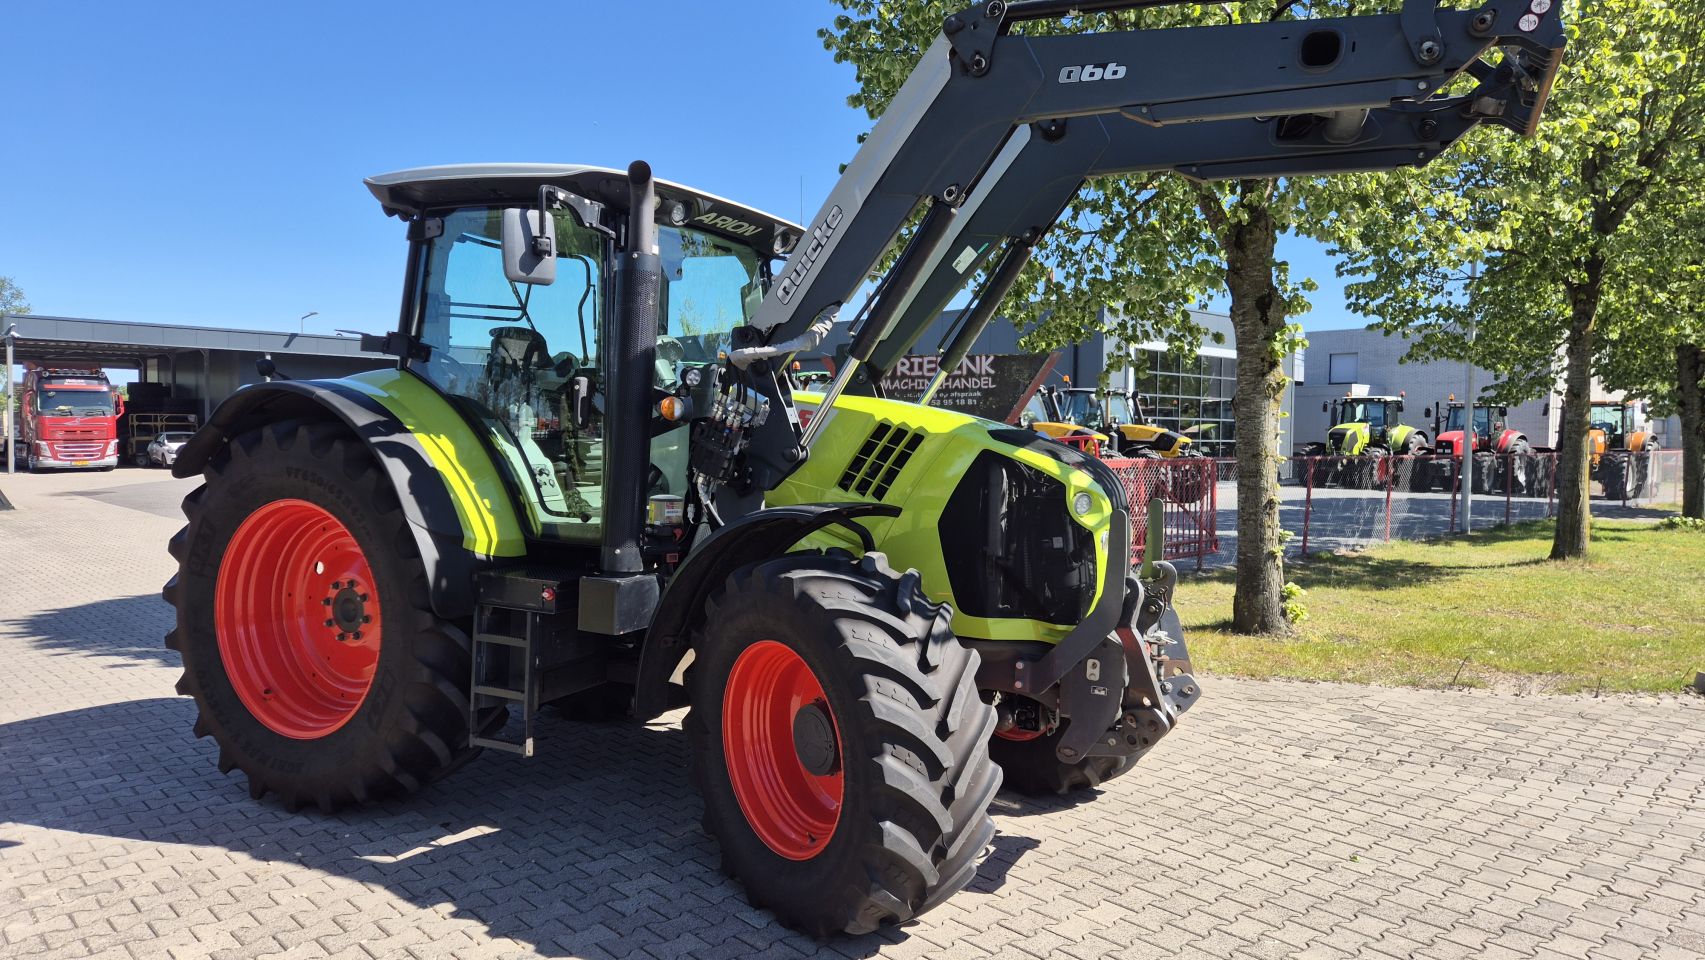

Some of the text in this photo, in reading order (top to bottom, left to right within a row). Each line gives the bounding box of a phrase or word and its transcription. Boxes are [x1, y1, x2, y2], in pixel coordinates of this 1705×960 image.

[1058, 62, 1127, 84] Q66
[694, 212, 763, 236] ARION
[886, 355, 996, 377] RIENK
[882, 376, 997, 391] MACHINHANDEL
[949, 390, 982, 399] afspraak
